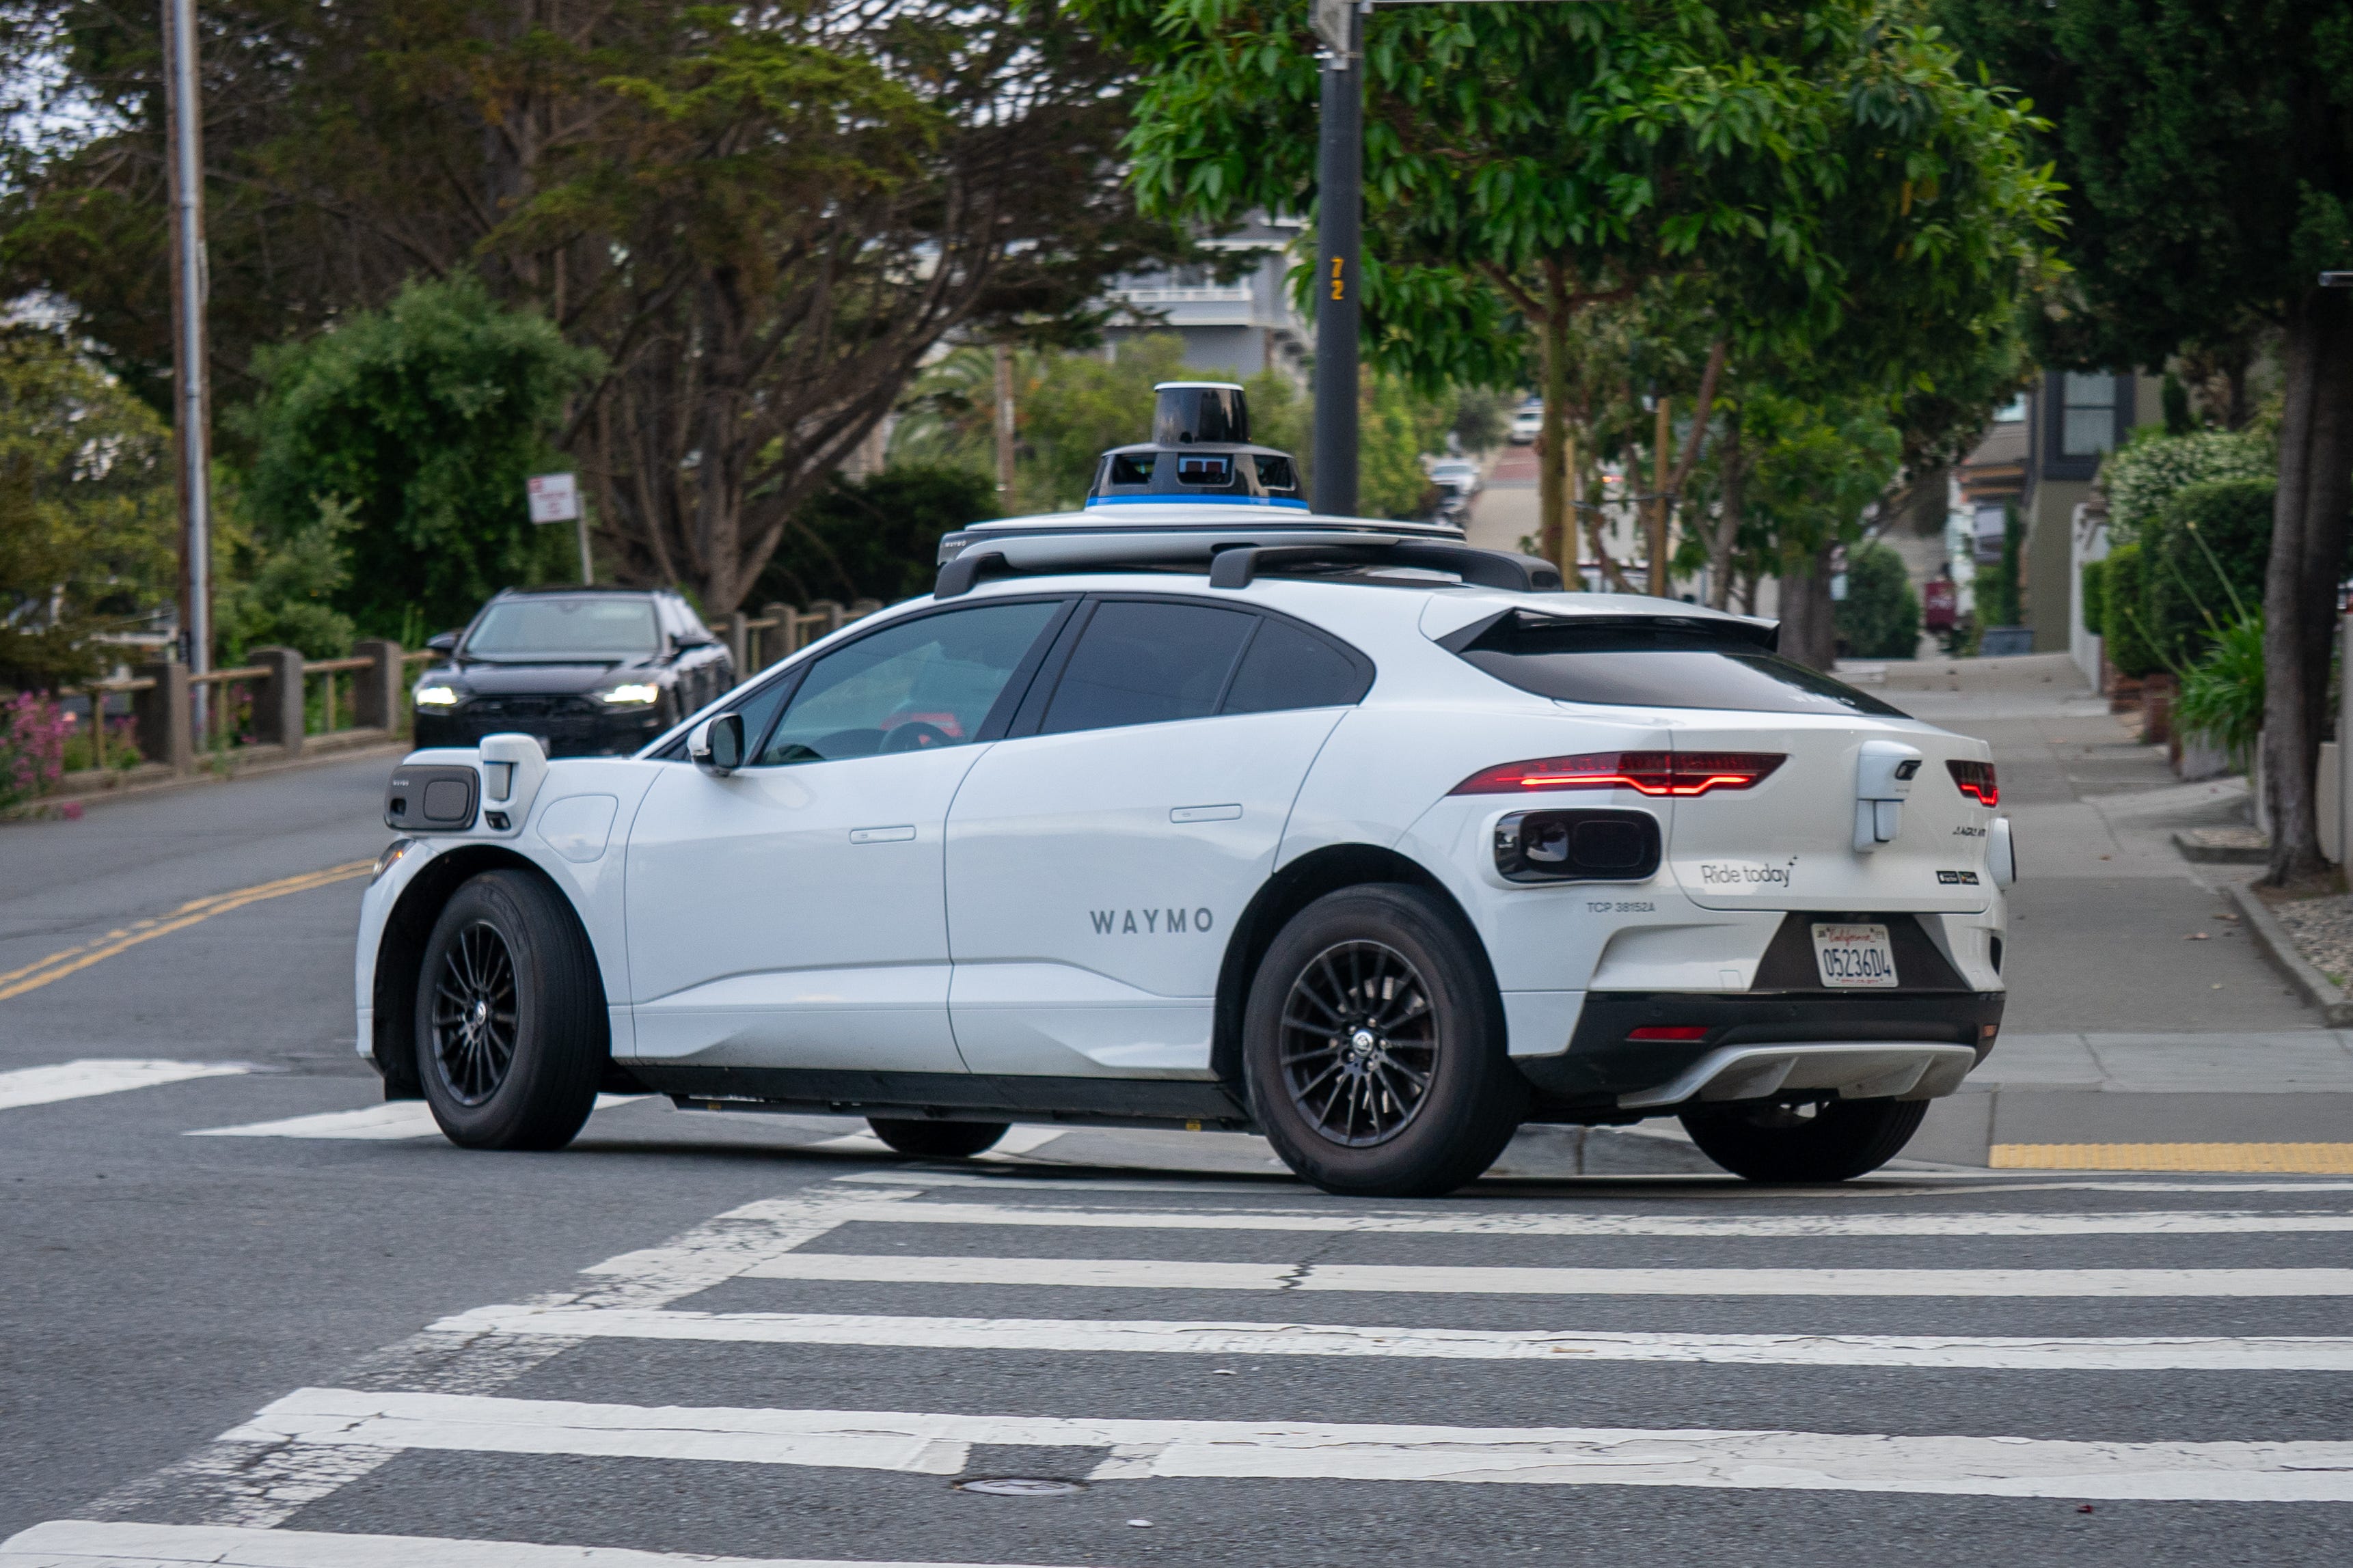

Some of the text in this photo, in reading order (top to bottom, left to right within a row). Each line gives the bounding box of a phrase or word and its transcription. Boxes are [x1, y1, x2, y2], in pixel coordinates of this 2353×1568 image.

[1702, 864, 1791, 888] Ride today
[1586, 903, 1613, 912] TCP
[1089, 907, 1214, 935] WAYMO
[1823, 948, 1892, 977] 05236D4
